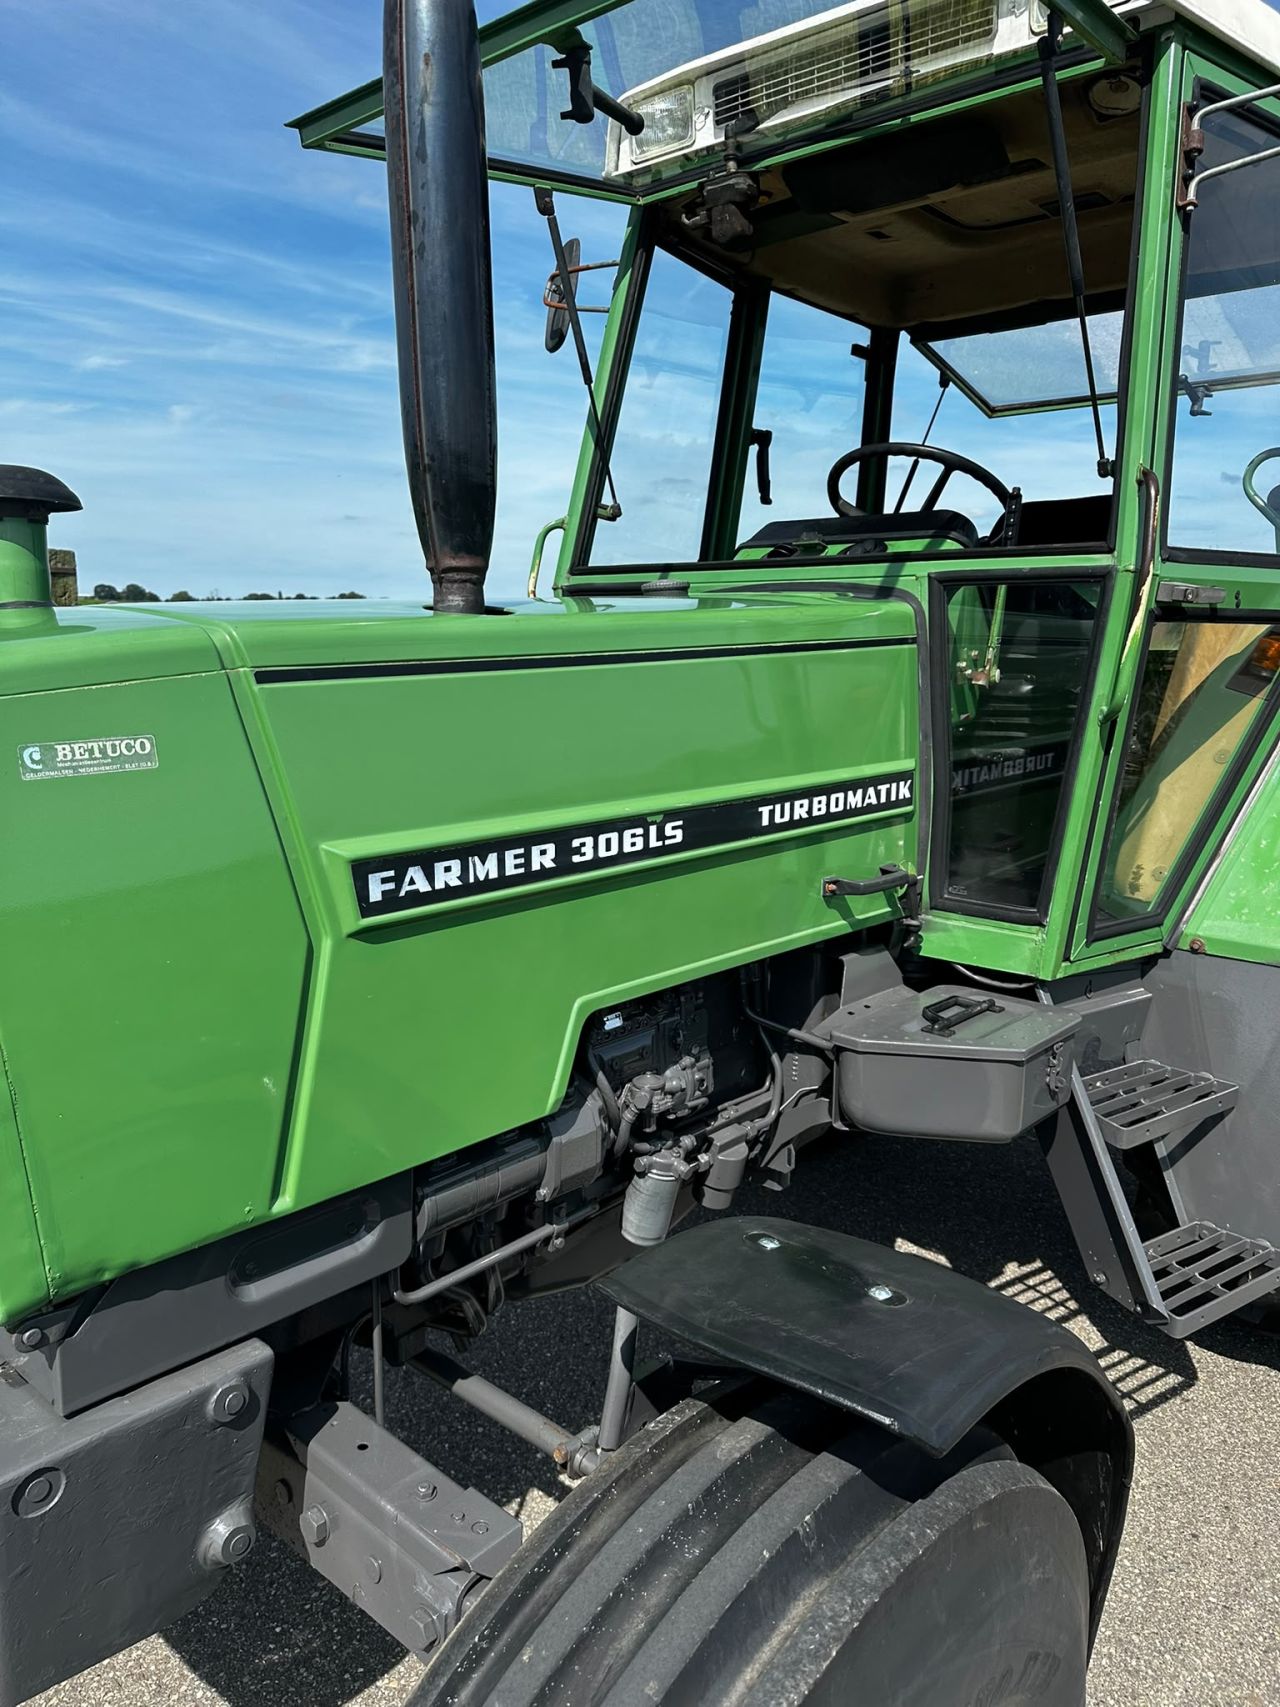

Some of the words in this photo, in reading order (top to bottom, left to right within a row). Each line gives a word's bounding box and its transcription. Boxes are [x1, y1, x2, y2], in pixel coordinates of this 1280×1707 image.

[54, 738, 151, 761] BETUCO
[368, 842, 556, 903] FARMER
[571, 819, 685, 863] 306LS
[757, 779, 912, 827] TURBOMATIK
